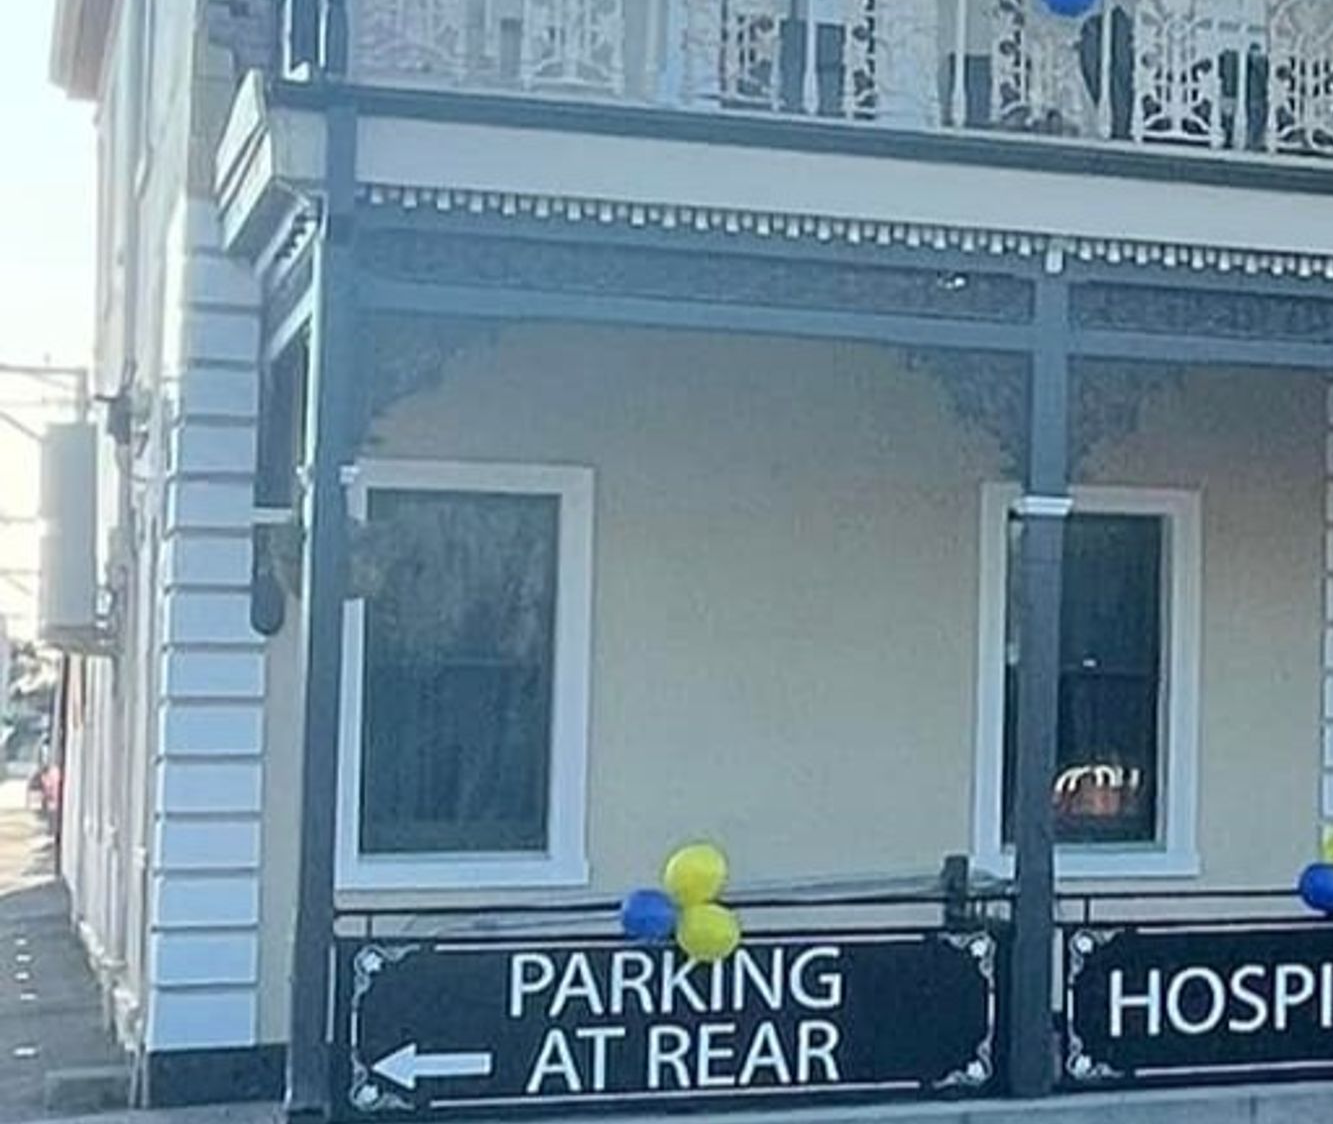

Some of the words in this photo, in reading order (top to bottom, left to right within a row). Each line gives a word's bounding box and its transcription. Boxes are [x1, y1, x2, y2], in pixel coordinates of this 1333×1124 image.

[508, 947, 842, 1019] PARKING
[525, 1027, 626, 1095] AT
[647, 1019, 840, 1090] REAR
